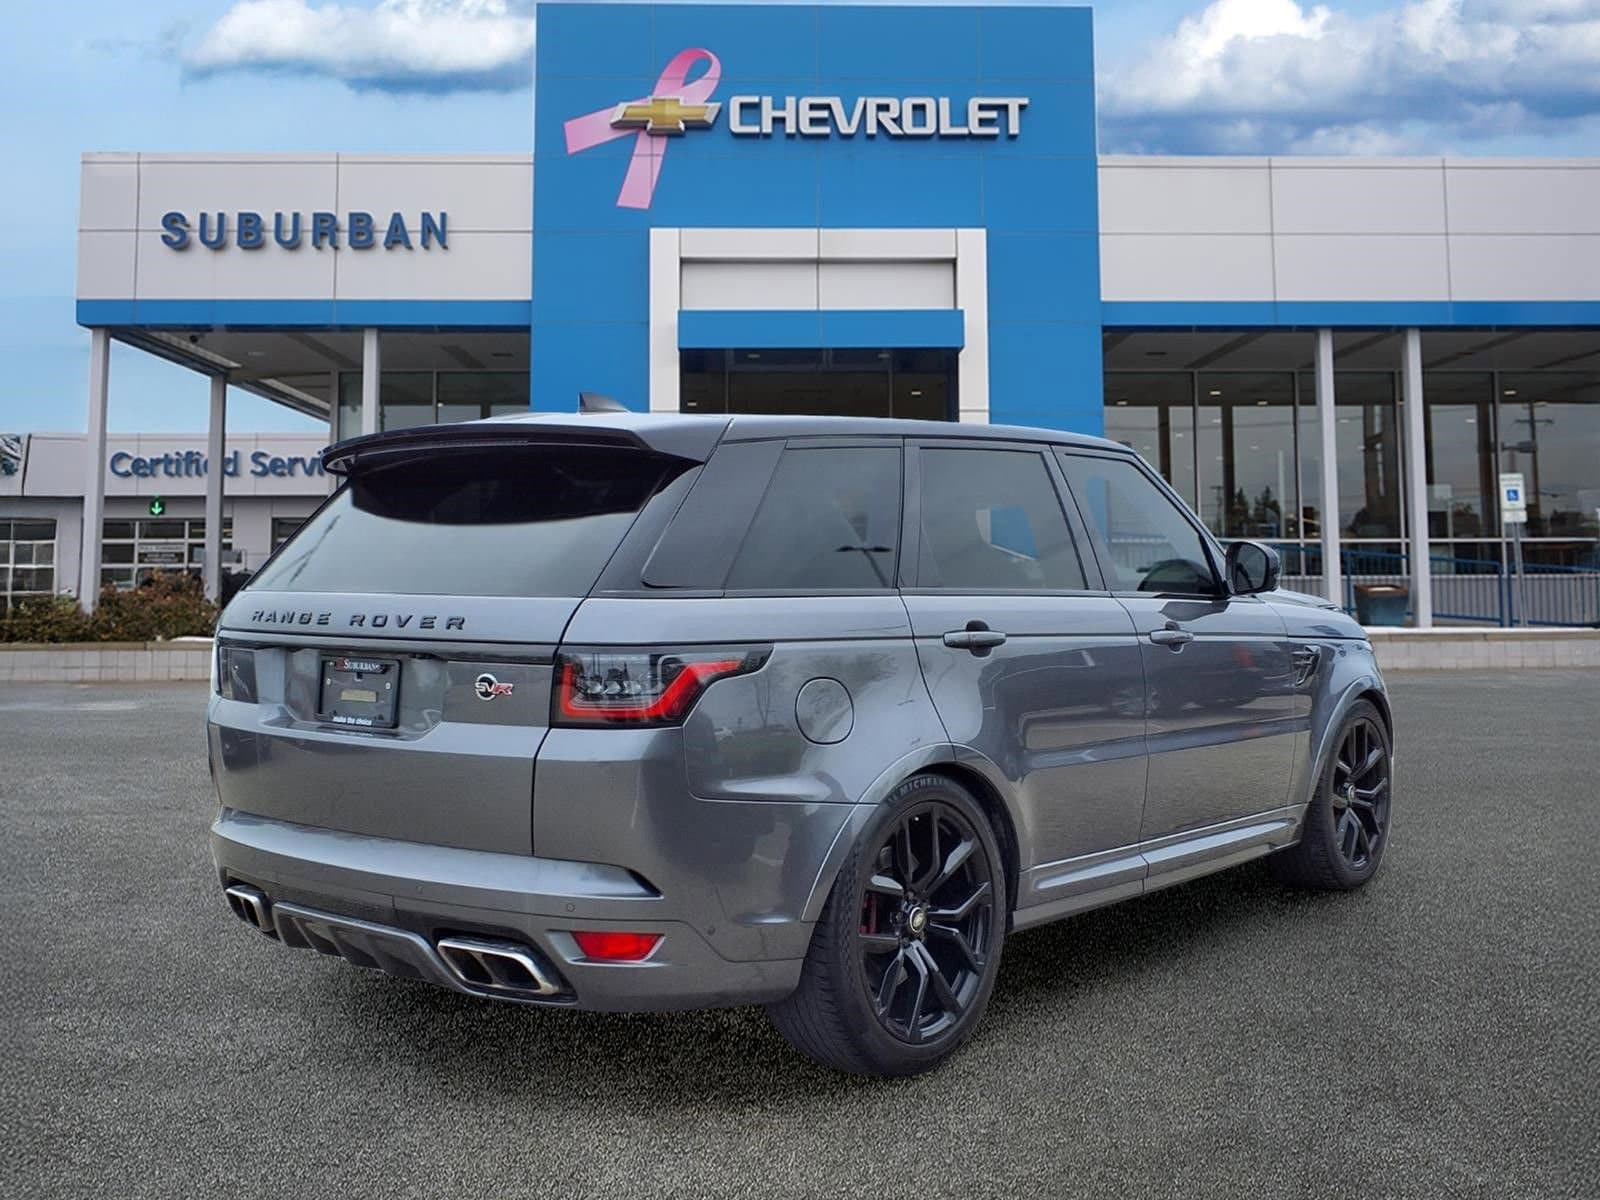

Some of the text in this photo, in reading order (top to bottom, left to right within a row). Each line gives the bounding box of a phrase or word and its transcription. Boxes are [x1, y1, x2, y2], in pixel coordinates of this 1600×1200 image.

[729, 95, 1029, 136] CHEVROLET
[160, 211, 449, 250] SUBURBAN
[250, 450, 325, 478] Servi
[251, 610, 466, 631] RANGE ROVER
[474, 681, 514, 697] SVR
